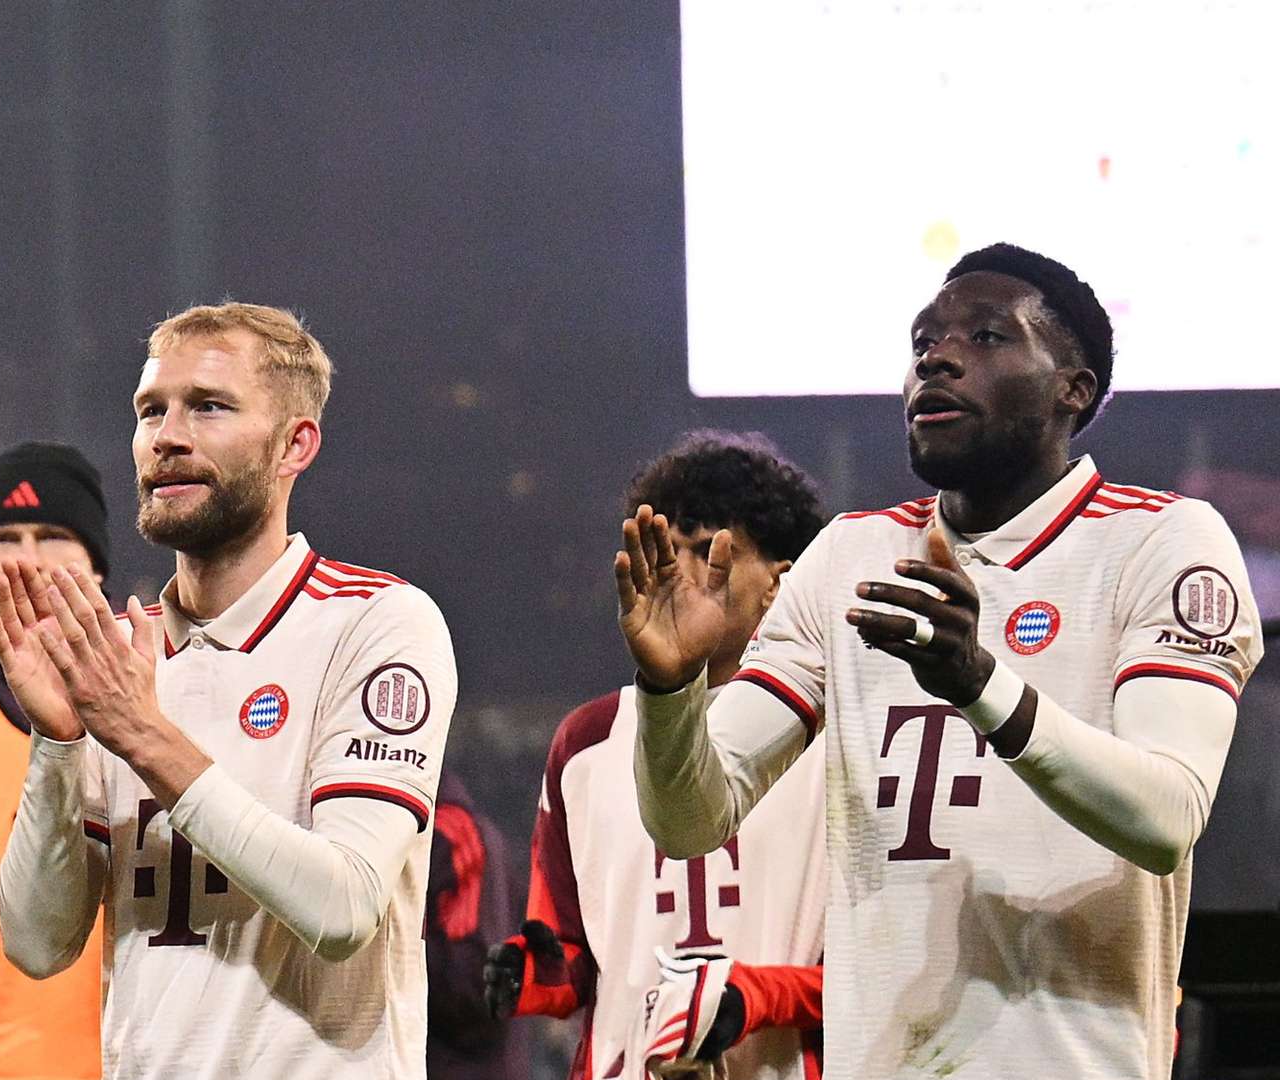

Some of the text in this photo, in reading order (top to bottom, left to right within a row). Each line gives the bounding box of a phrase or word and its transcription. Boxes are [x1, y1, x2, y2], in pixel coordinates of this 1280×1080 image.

[344, 737, 427, 770] Allianz
[876, 705, 987, 861] T
[134, 799, 228, 947] T
[655, 836, 740, 949] T
